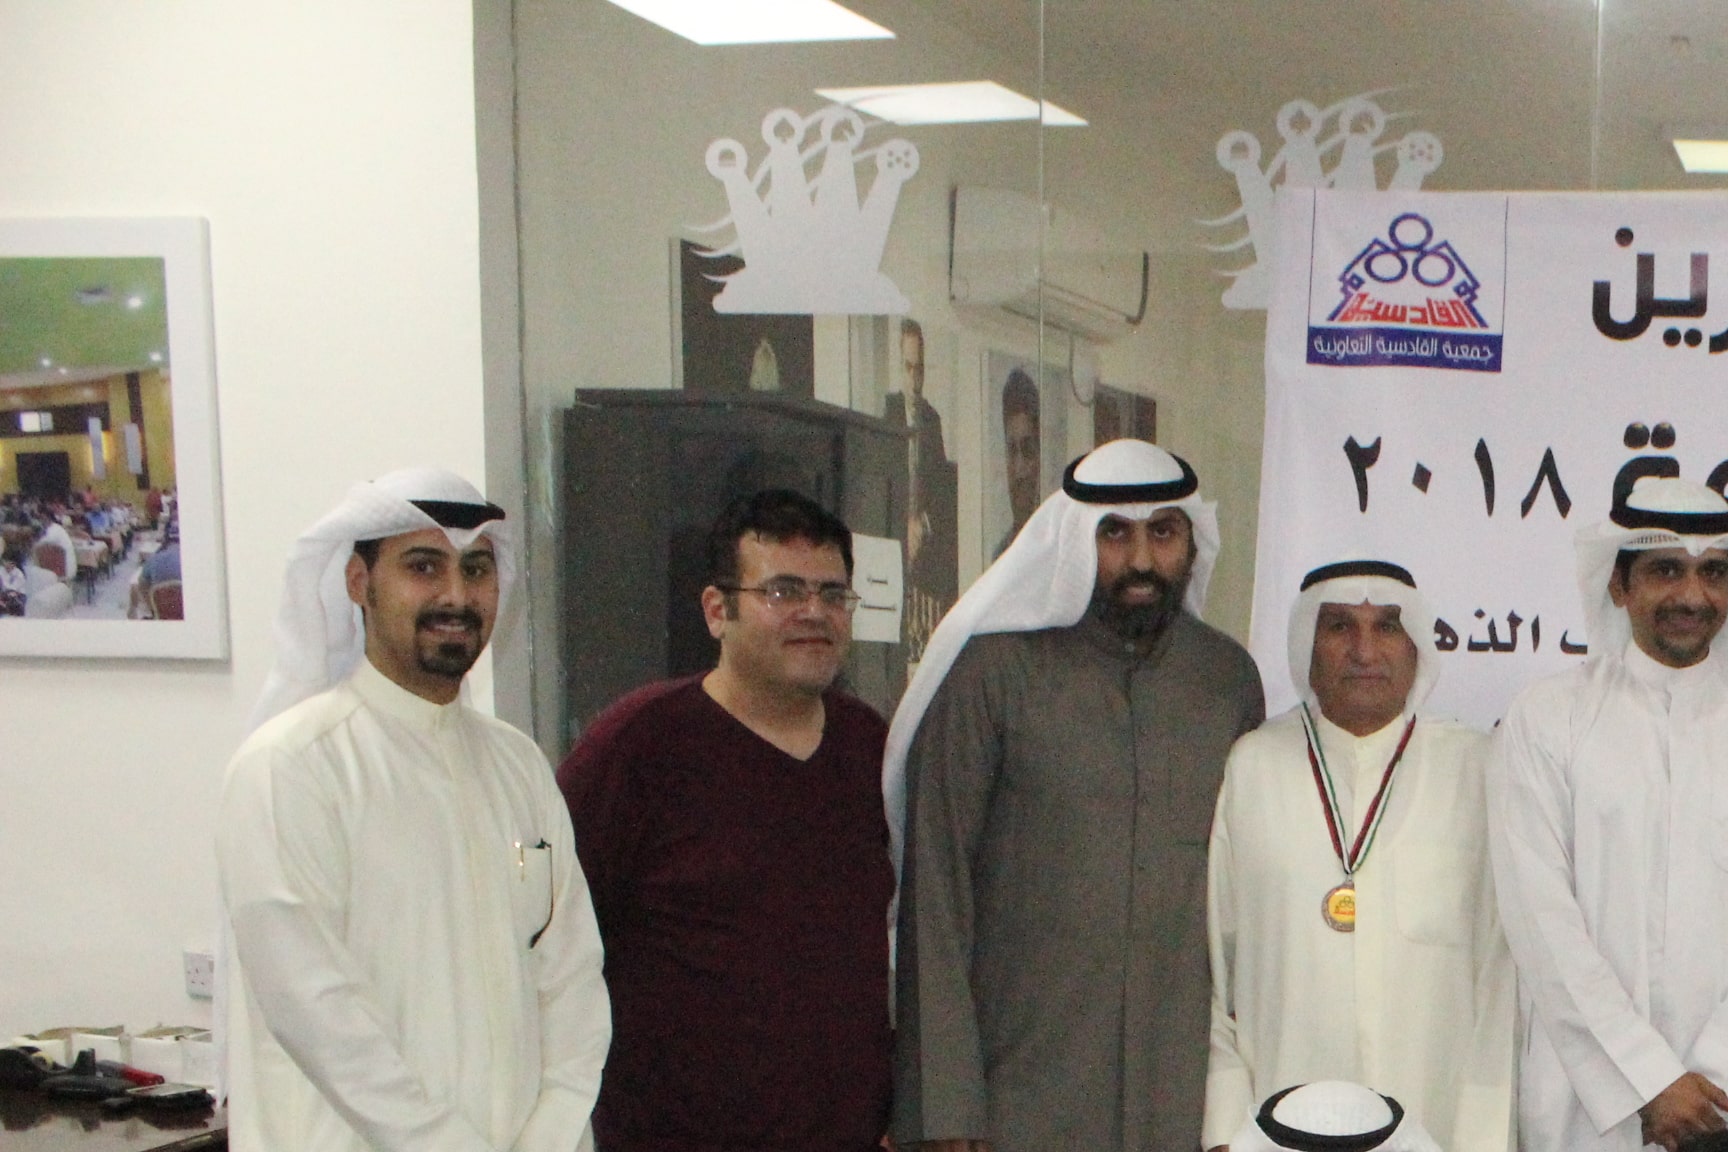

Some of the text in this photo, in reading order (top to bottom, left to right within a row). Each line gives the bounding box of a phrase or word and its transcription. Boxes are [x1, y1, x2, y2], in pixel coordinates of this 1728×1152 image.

[1313, 333, 1495, 366] جمعية القادسية التعاونية
[1342, 434, 1573, 520] ٢٠١٨
[1434, 608, 1541, 653] الذه
